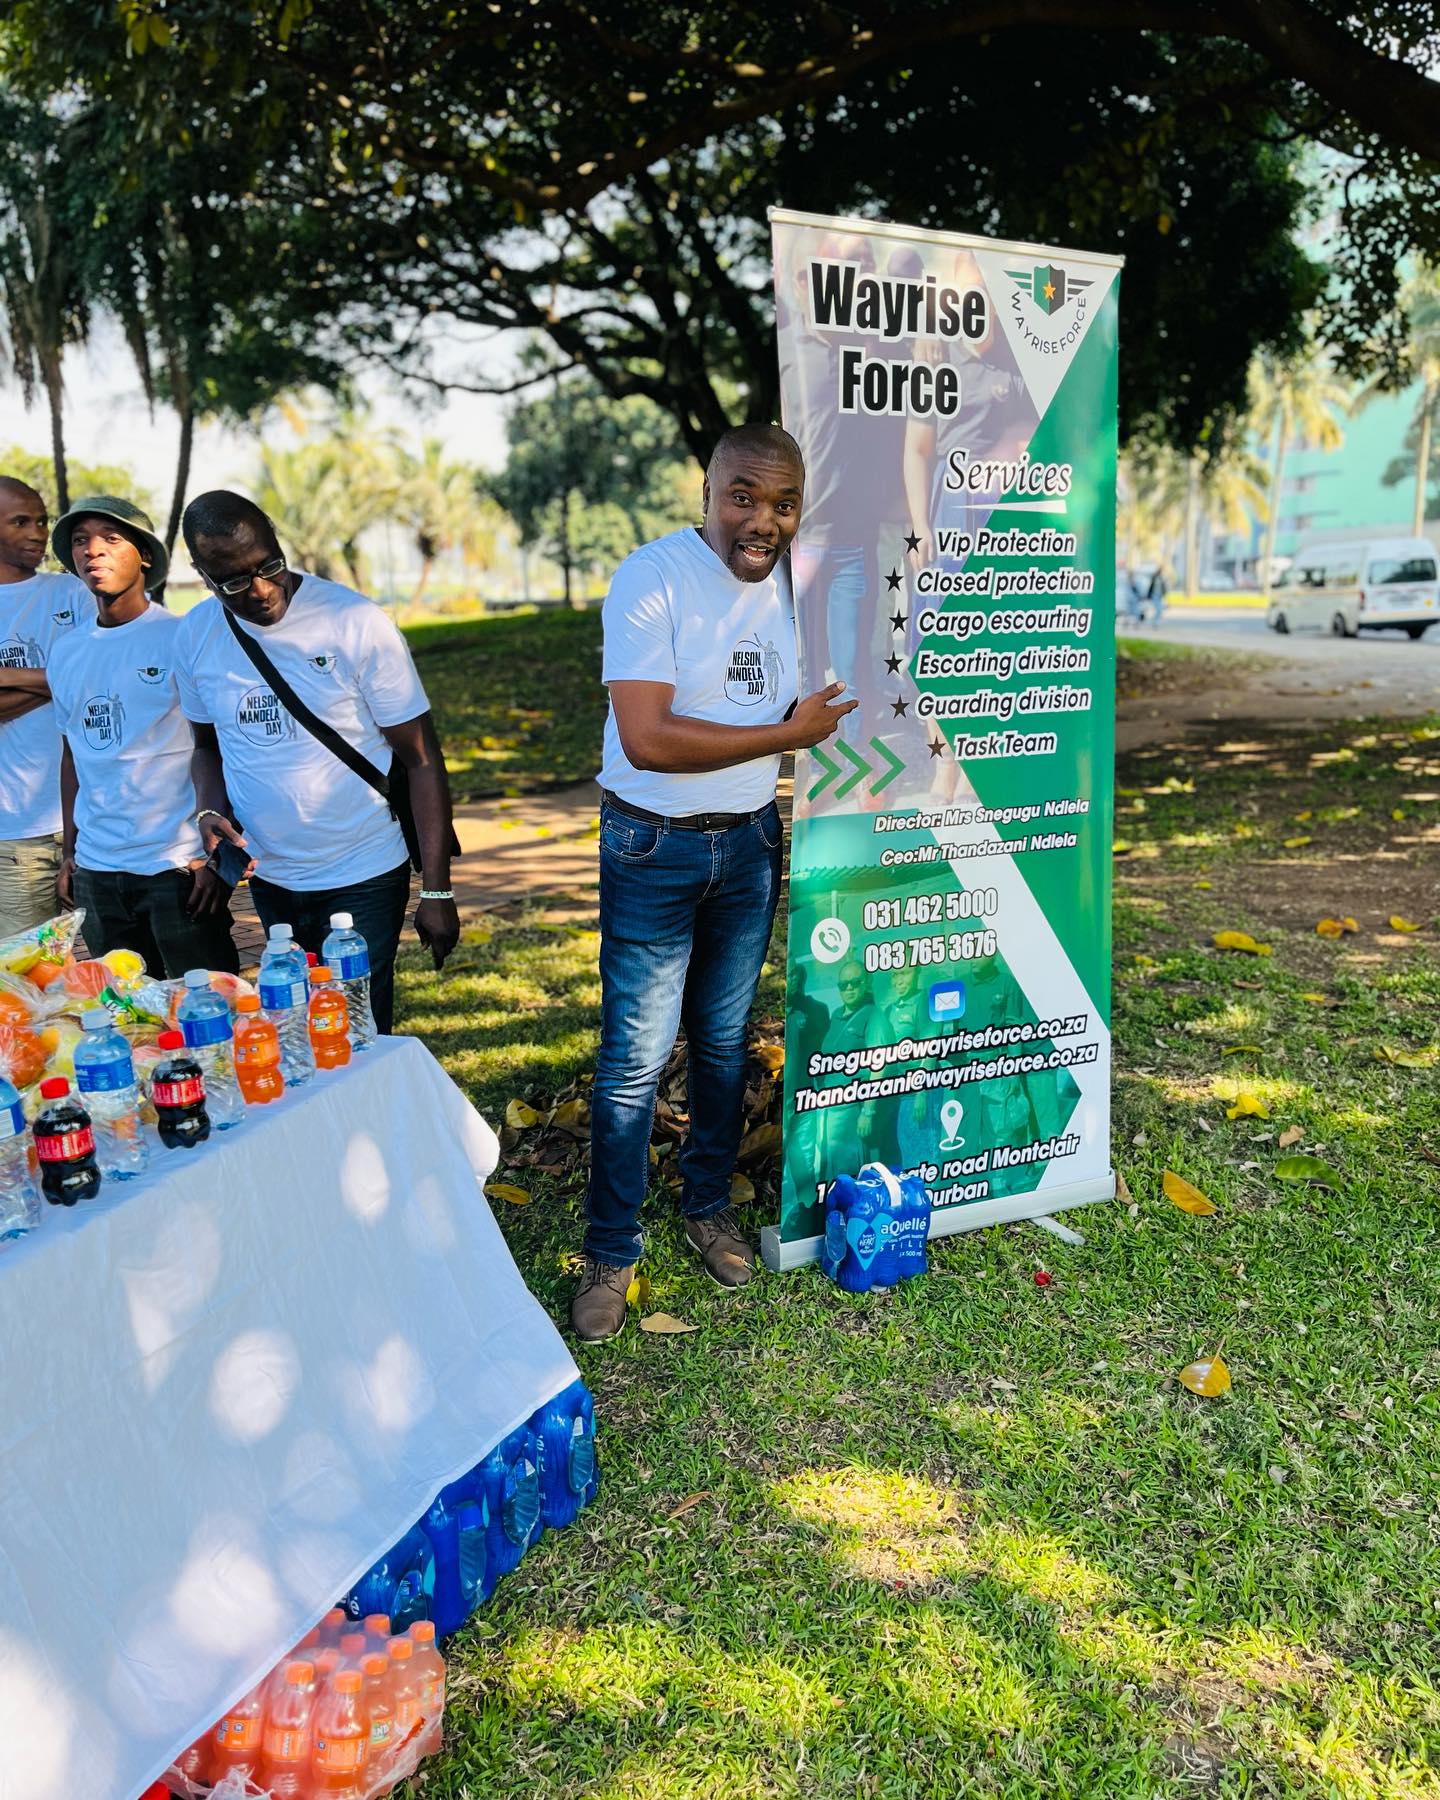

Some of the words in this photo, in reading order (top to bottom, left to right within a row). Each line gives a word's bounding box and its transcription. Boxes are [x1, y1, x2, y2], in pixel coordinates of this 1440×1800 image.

[811, 262, 986, 339] Wayrise
[842, 350, 959, 416] Force
[946, 450, 1072, 493] Services
[938, 531, 970, 557] Vip
[977, 531, 1075, 553] Protection
[917, 570, 991, 592] Closed
[995, 570, 1092, 595] protection
[919, 611, 984, 637] Cargo
[991, 608, 1089, 633] escourting
[732, 651, 762, 667] NELSON
[919, 652, 1012, 677] Escorting
[1018, 648, 1088, 671] division
[728, 667, 764, 682] MANDELA
[747, 681, 765, 695] DAY
[239, 708, 280, 724] MANDELA
[246, 695, 279, 709] NELSON
[918, 692, 1013, 718] Guarding
[1019, 689, 1089, 711] division
[100, 728, 112, 740] DAY
[265, 721, 282, 736] DAY
[956, 737, 998, 757] Task
[1004, 734, 1055, 754] Team
[874, 812, 942, 833] Director:
[944, 808, 972, 826] Mrs
[975, 803, 1041, 825] Snegugu
[1044, 799, 1090, 817] Ndlela
[940, 838, 1026, 860] Thandazani
[1030, 833, 1077, 851] Ndlela
[863, 899, 900, 930] 031
[904, 894, 943, 926] 462
[946, 888, 998, 920] 5000
[864, 941, 905, 973] 083
[909, 936, 945, 967] 765
[949, 929, 998, 961] 3676
[808, 1014, 1087, 1077] Snegugu@wayriseforce.co.za
[795, 1043, 1098, 1114] Thandazani@wayriseforce.co.za
[942, 1150, 989, 1179] road
[990, 1133, 1080, 1169] Montclair
[880, 1217, 927, 1237] aQuellé
